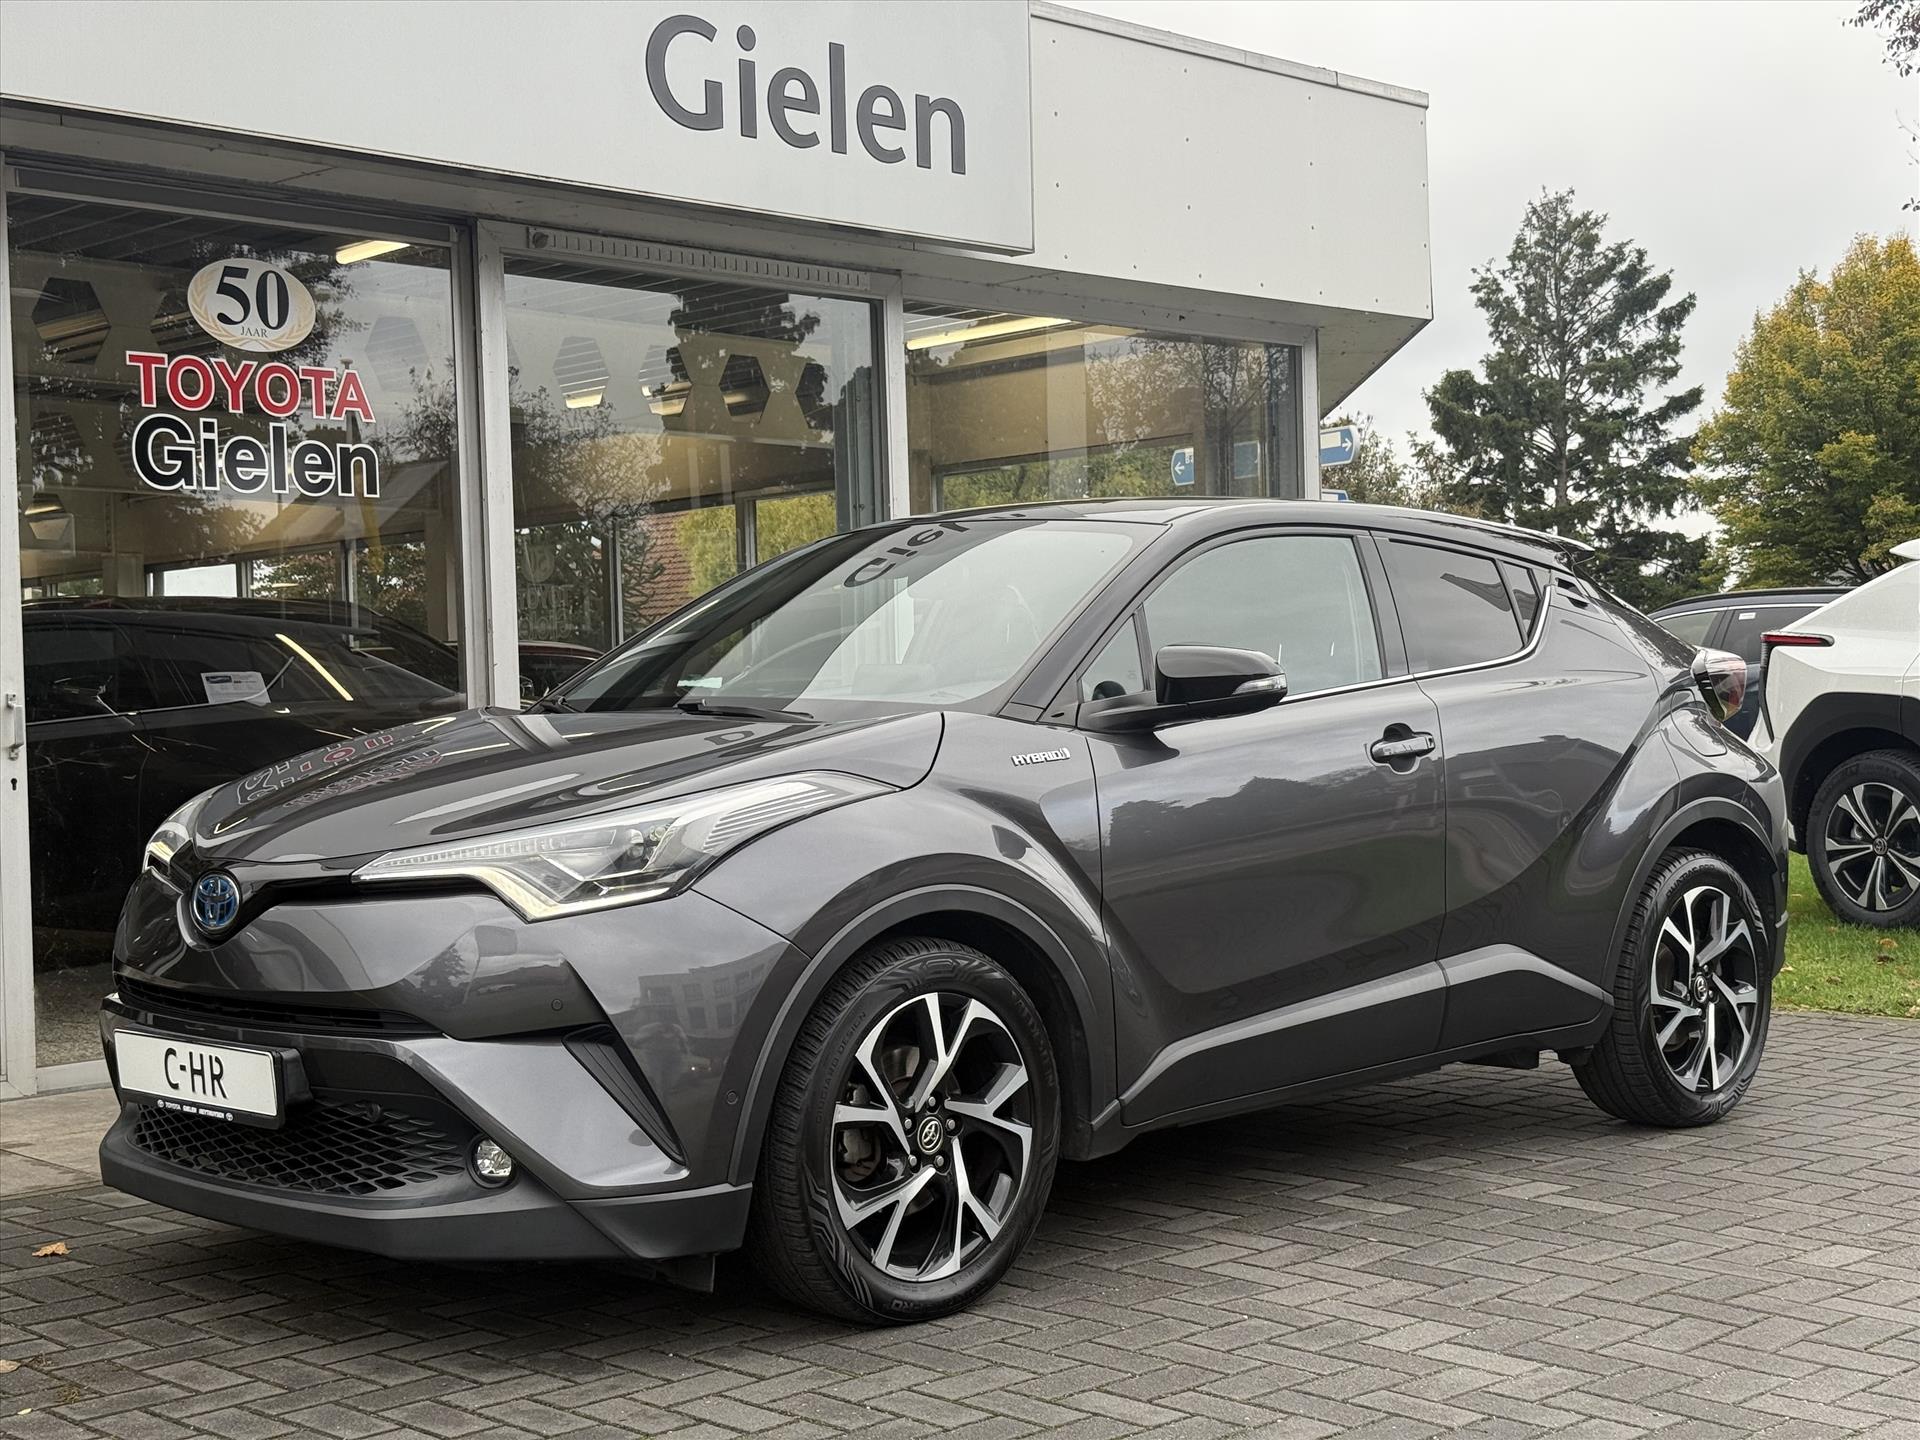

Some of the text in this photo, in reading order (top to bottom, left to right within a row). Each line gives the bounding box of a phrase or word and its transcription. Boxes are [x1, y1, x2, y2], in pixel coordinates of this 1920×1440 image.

[645, 14, 966, 175] Gielen
[216, 266, 290, 330] 50
[240, 326, 269, 339] JAAR
[126, 351, 376, 422] TOYOTA
[132, 413, 380, 498] Gielen
[1011, 749, 1061, 767] HYBRID
[164, 1047, 228, 1099] C-HR
